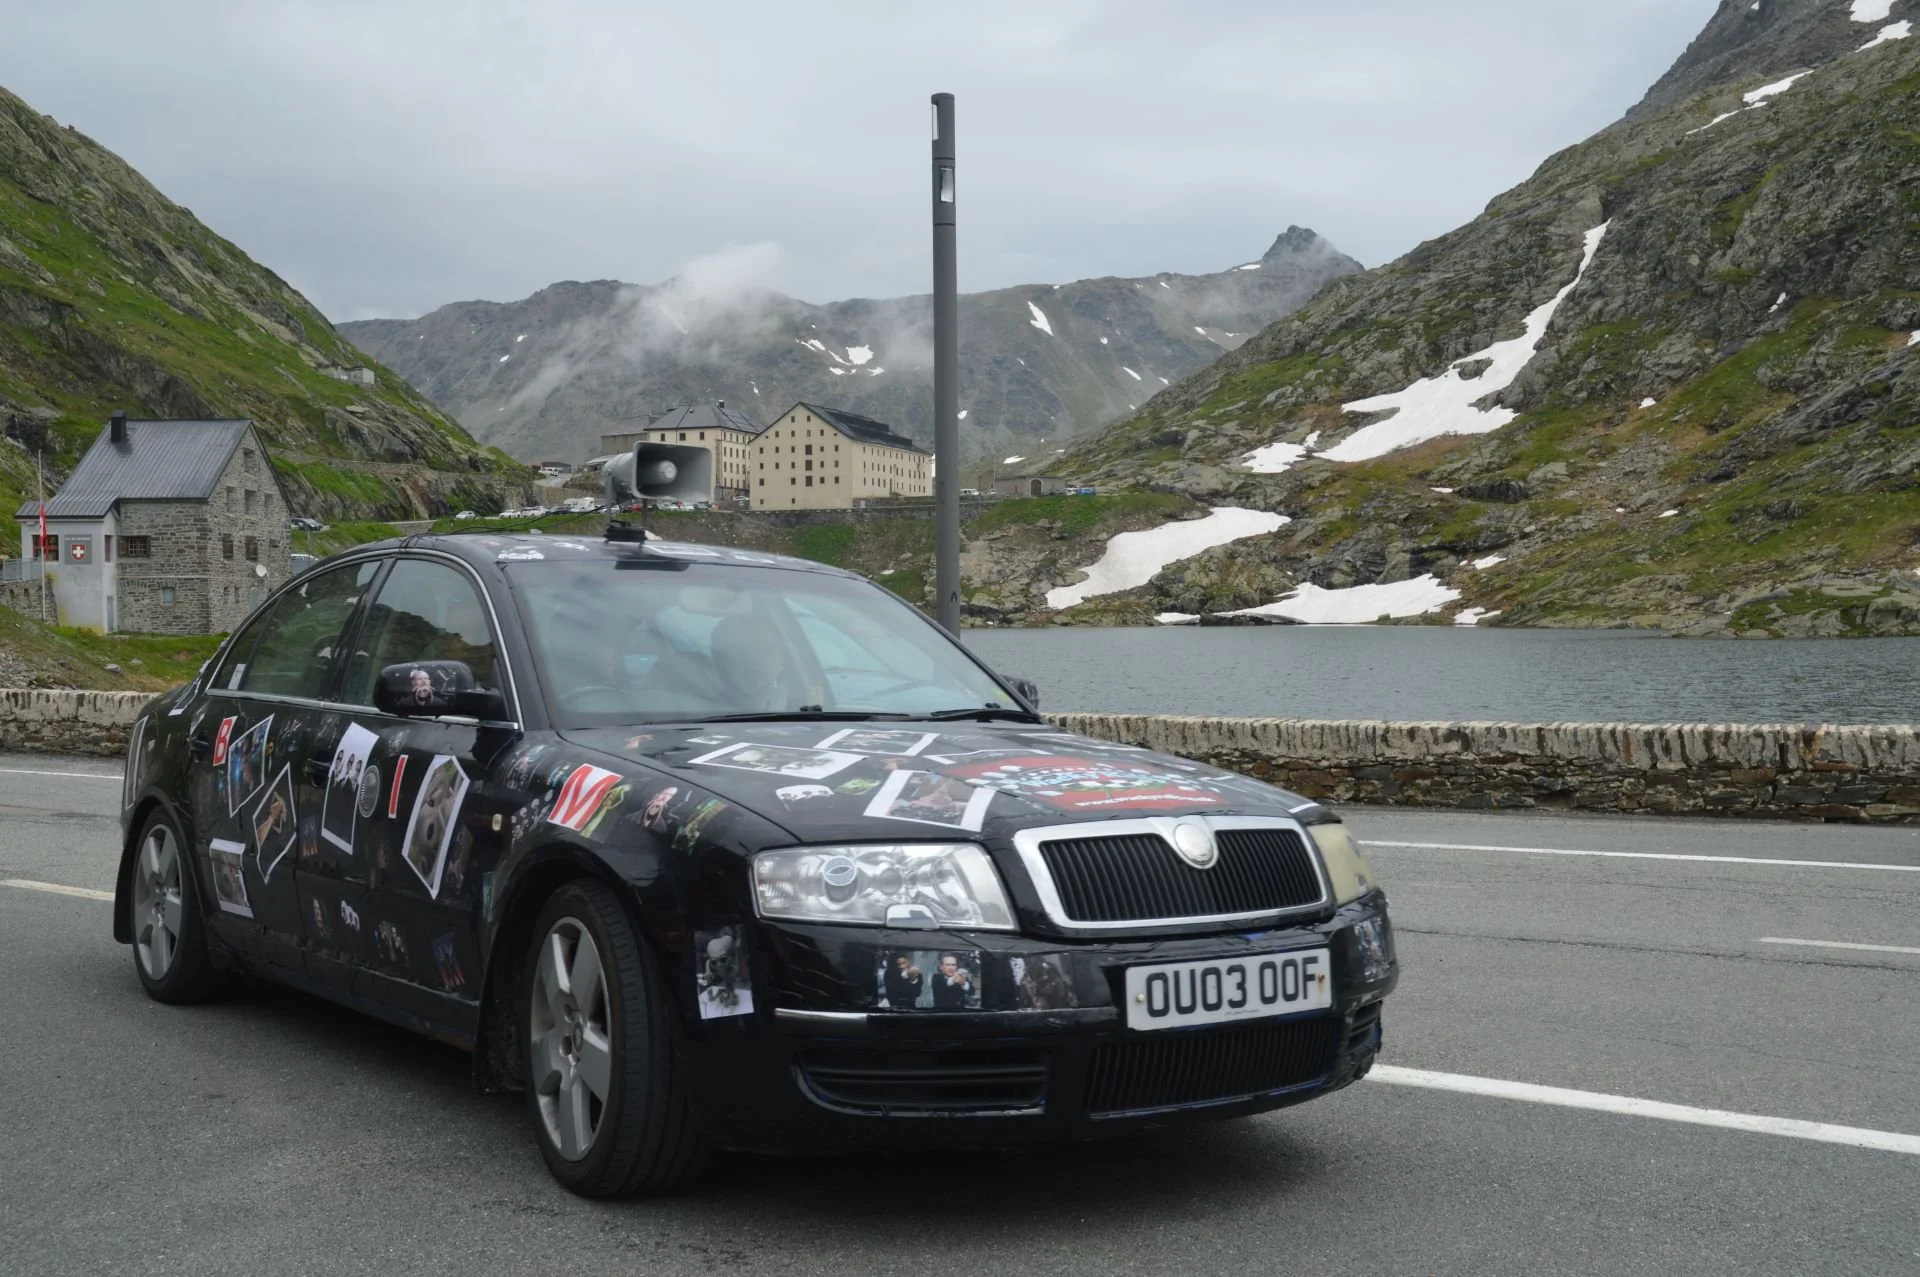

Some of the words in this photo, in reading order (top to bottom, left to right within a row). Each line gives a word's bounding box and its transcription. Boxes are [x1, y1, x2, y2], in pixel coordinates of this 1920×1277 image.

[213, 718, 235, 765] B
[550, 765, 622, 830] M
[1146, 964, 1247, 1018] OU03
[1259, 956, 1319, 1005] OOF
